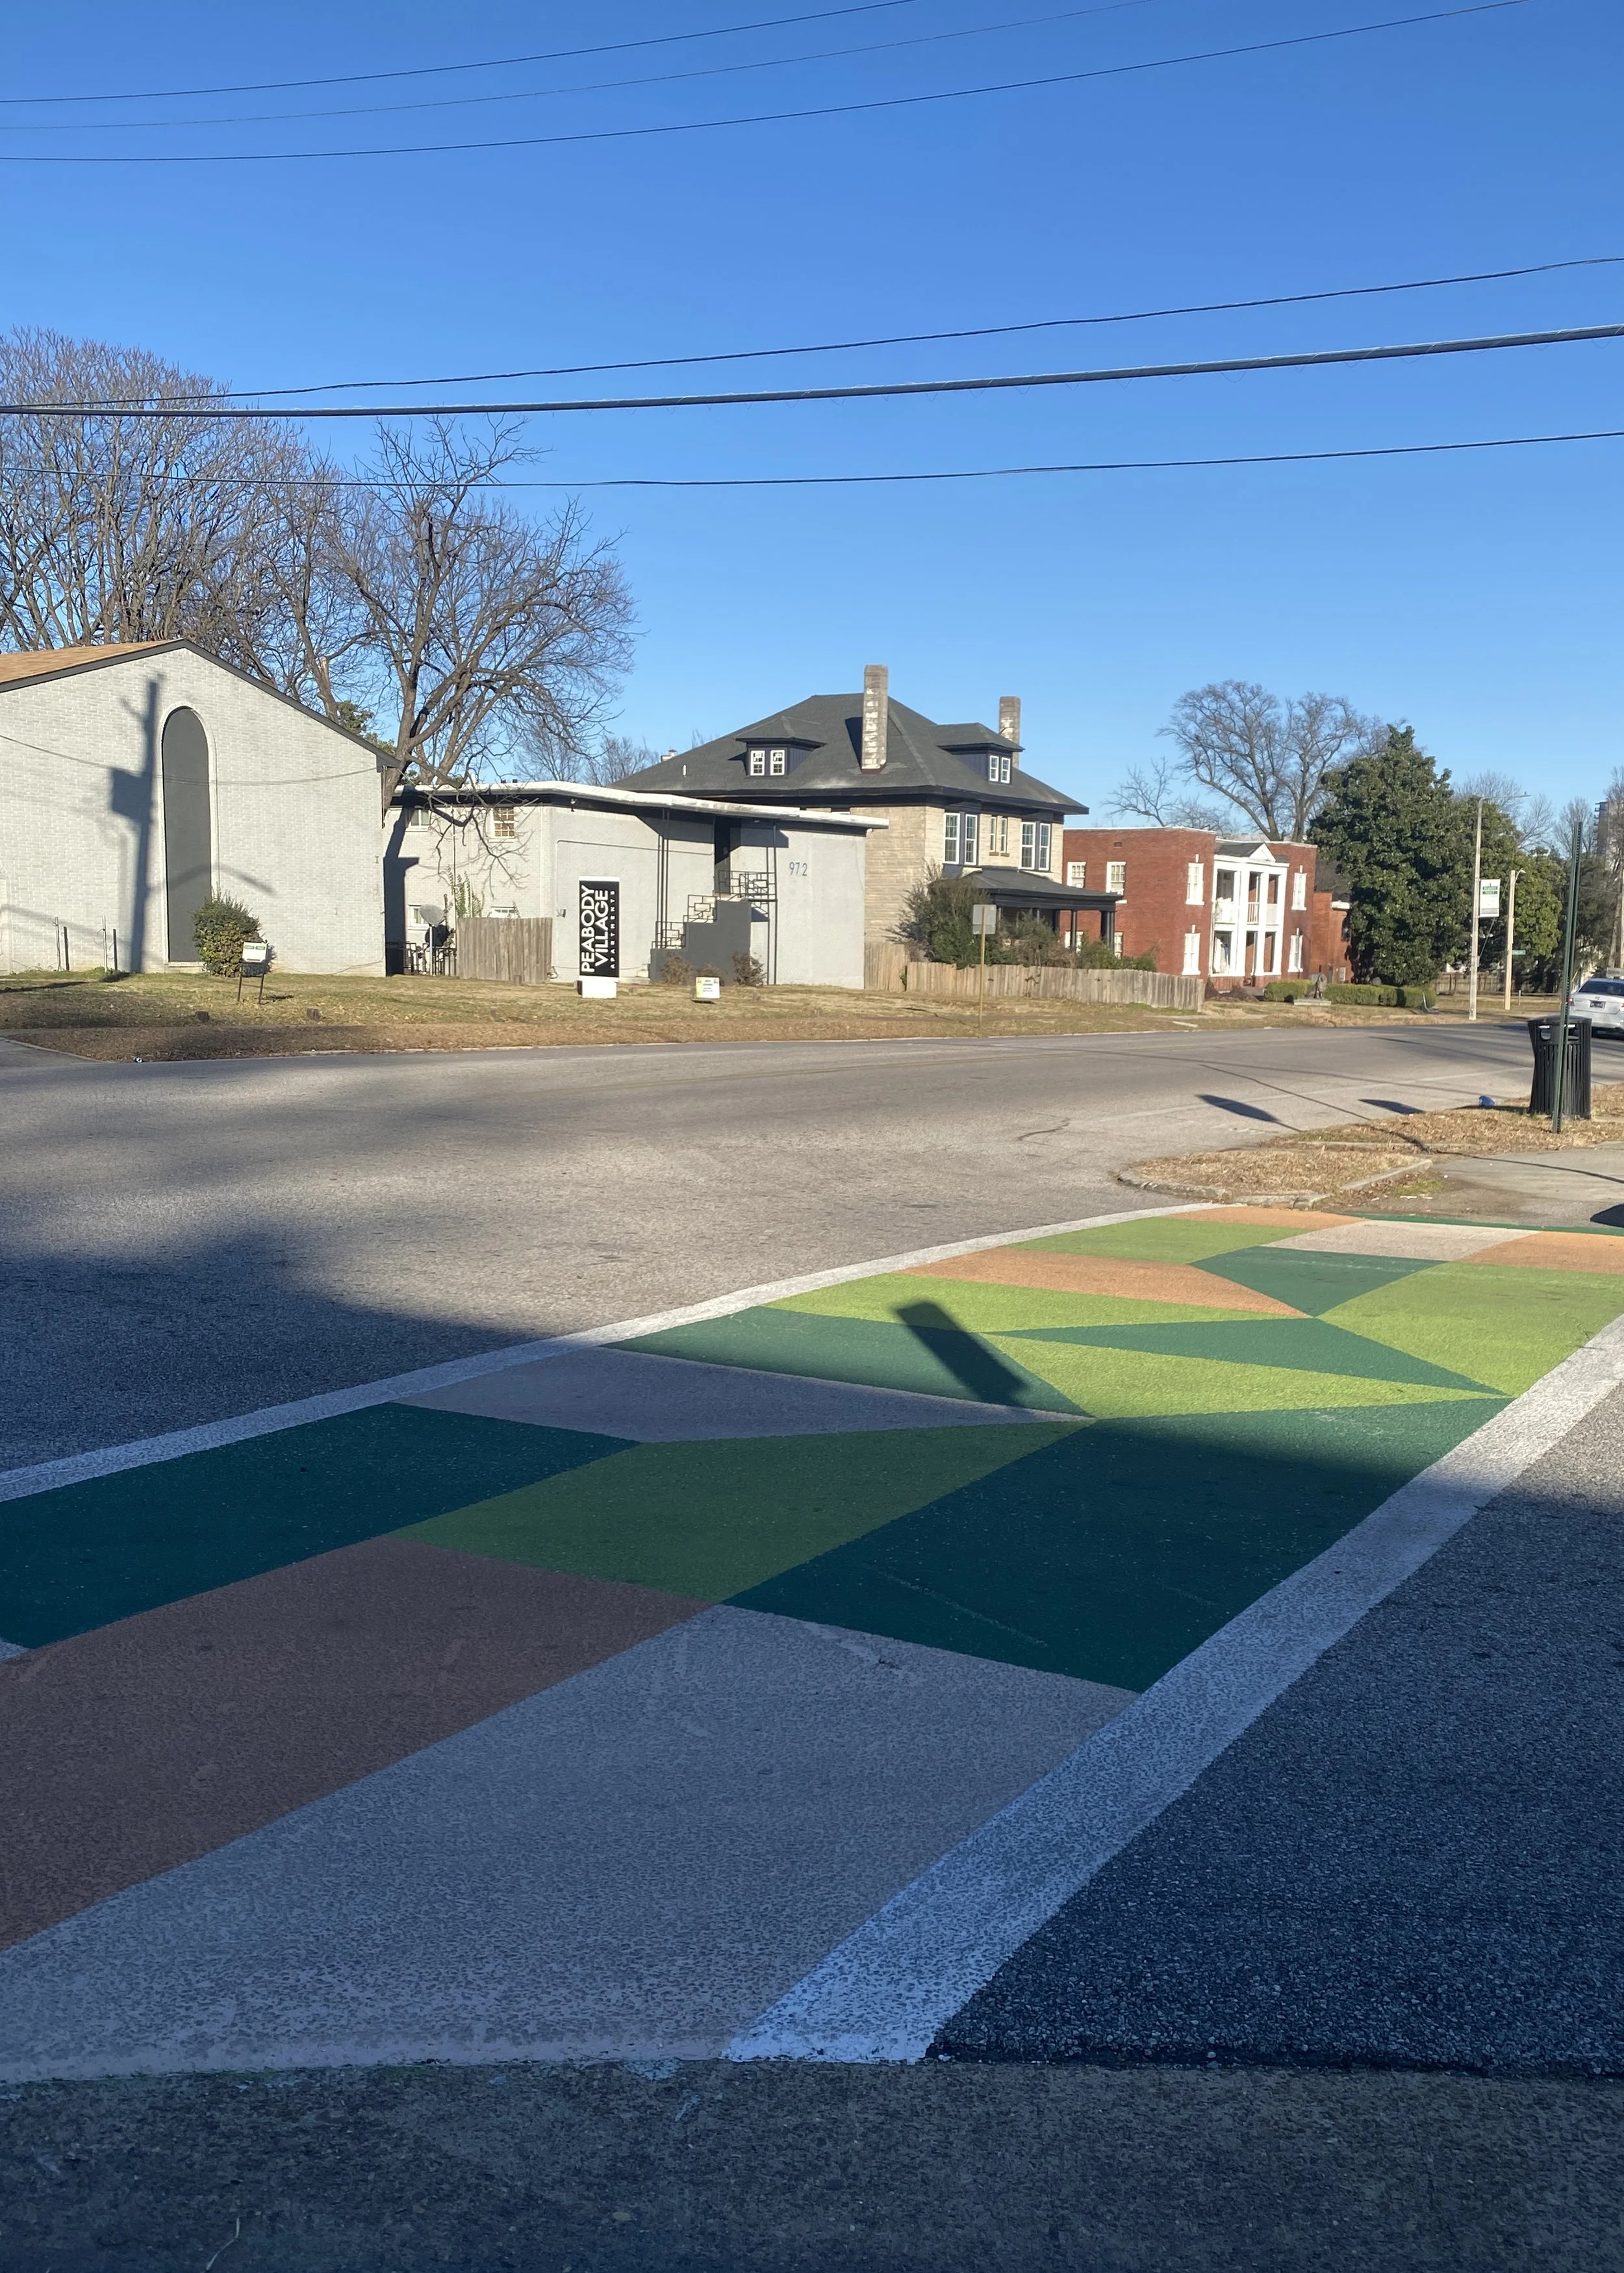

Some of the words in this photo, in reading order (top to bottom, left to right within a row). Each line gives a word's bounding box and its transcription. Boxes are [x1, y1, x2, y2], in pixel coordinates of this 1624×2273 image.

[789, 861, 808, 876] 972
[581, 884, 595, 972] PEABODY
[594, 889, 609, 967] VILLAGE
